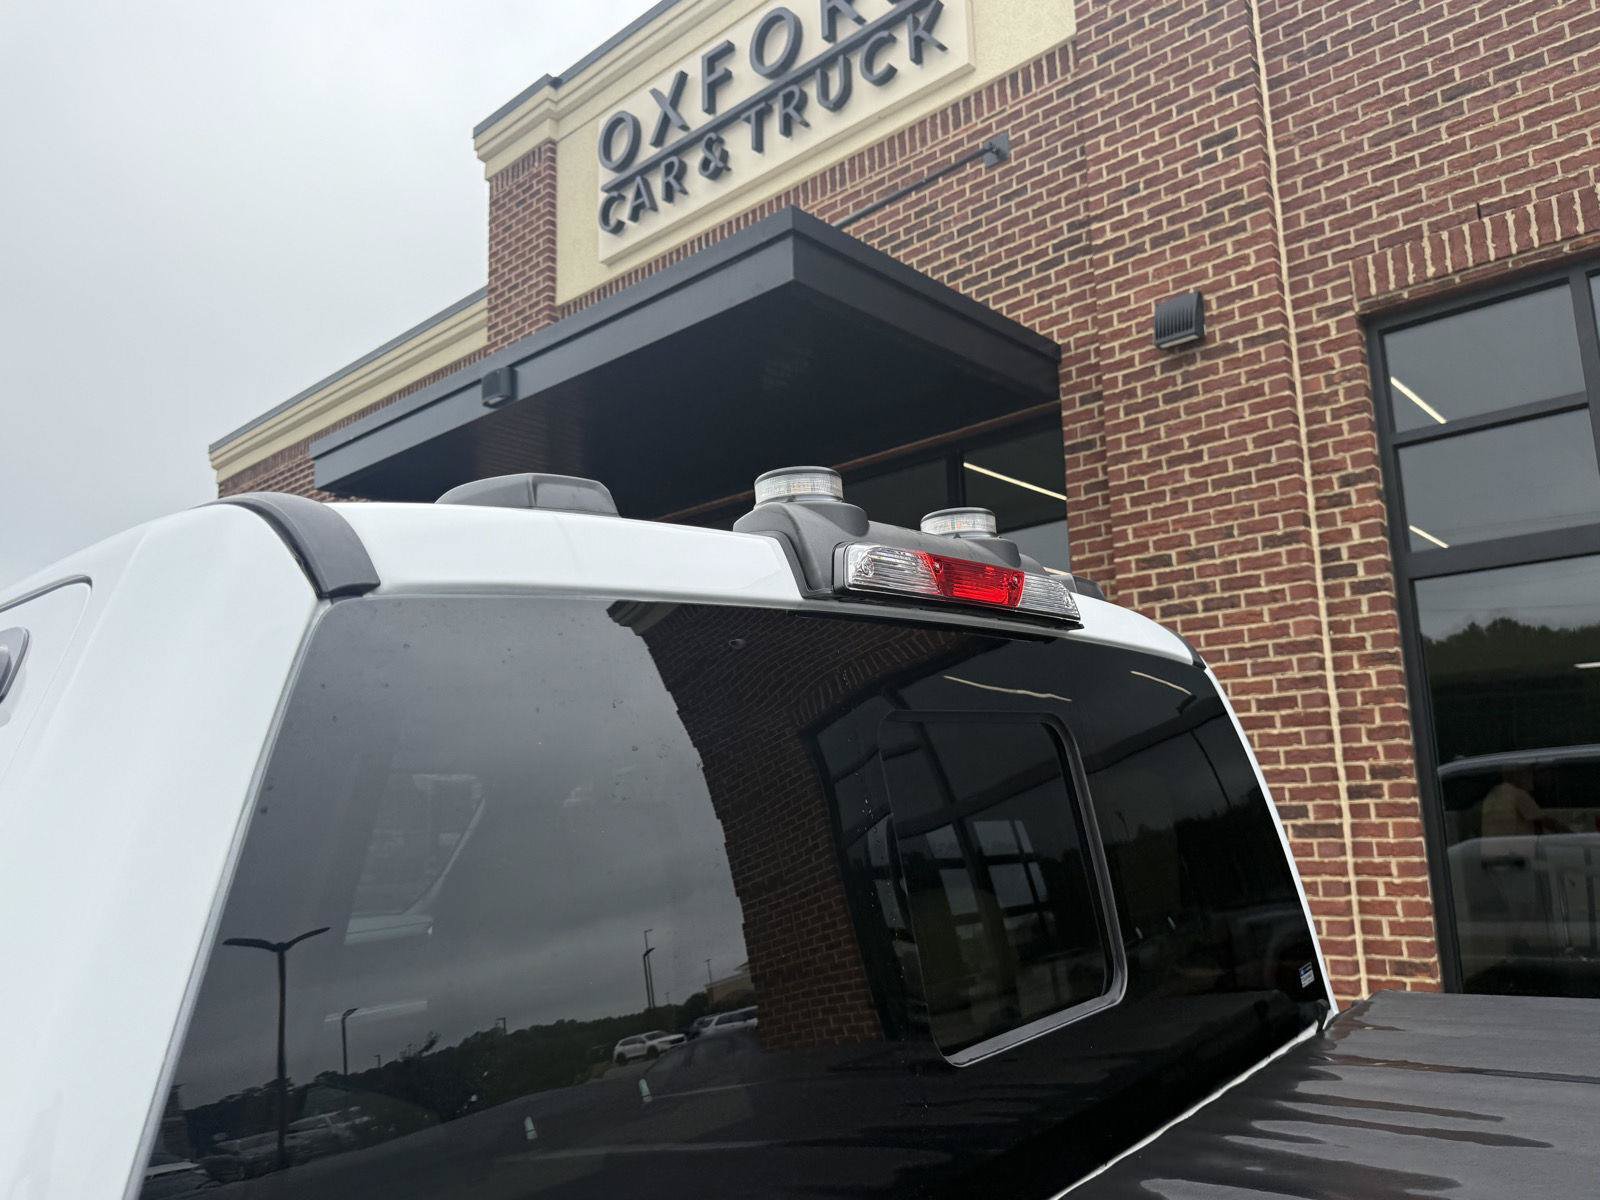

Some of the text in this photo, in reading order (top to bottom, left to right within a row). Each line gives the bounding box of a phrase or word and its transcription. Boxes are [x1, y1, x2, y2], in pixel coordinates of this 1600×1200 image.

[598, 0, 898, 173] OXFOR
[599, 0, 949, 235] CAR & TRUCK
